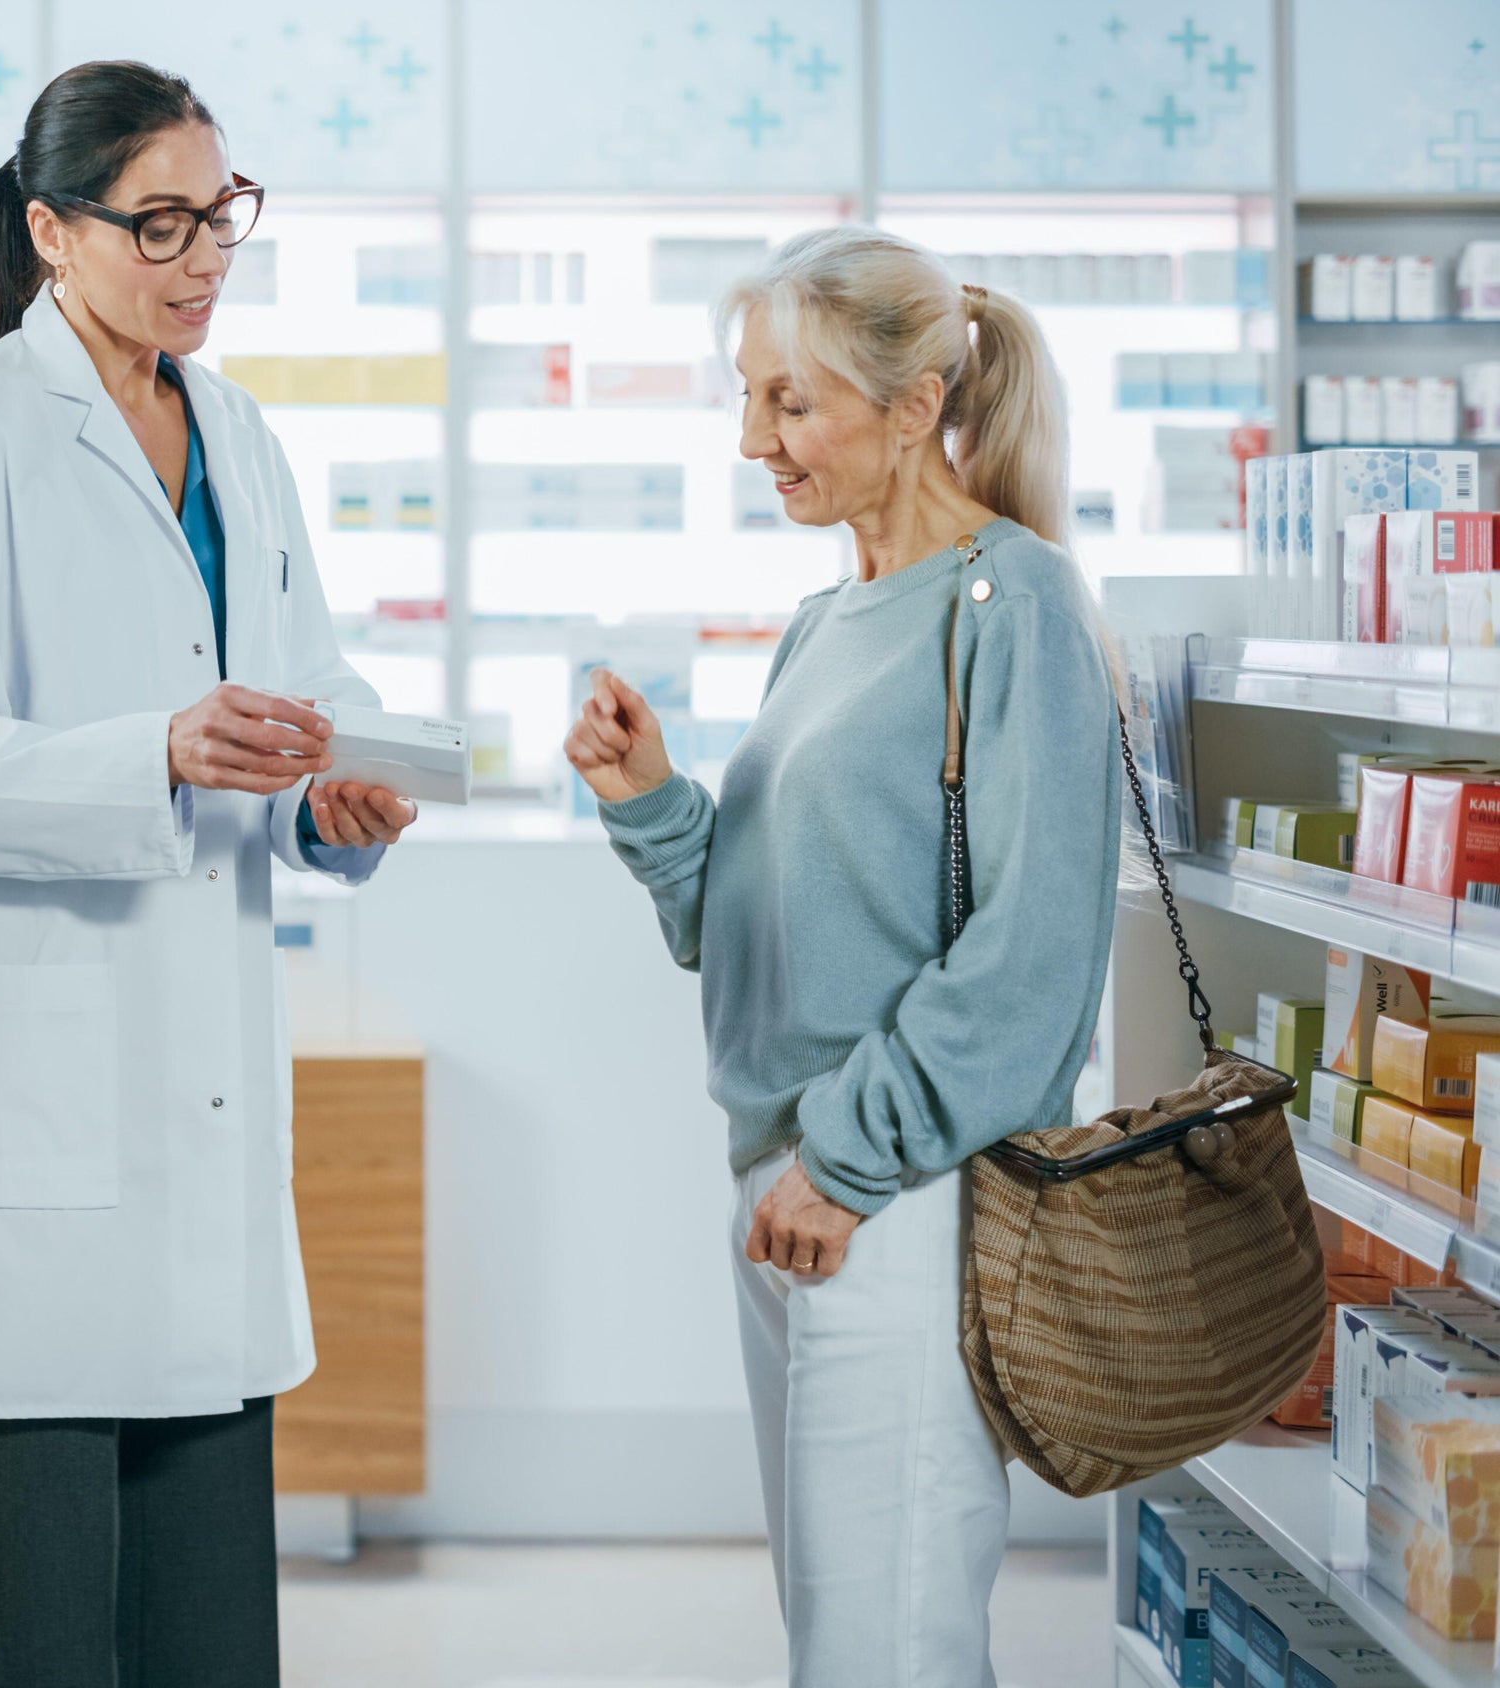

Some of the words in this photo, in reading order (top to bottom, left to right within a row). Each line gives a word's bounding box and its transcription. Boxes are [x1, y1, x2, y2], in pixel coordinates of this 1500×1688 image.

[422, 720, 443, 730] Brain
[444, 723, 463, 733] Help
[1376, 982, 1388, 1013] Well
